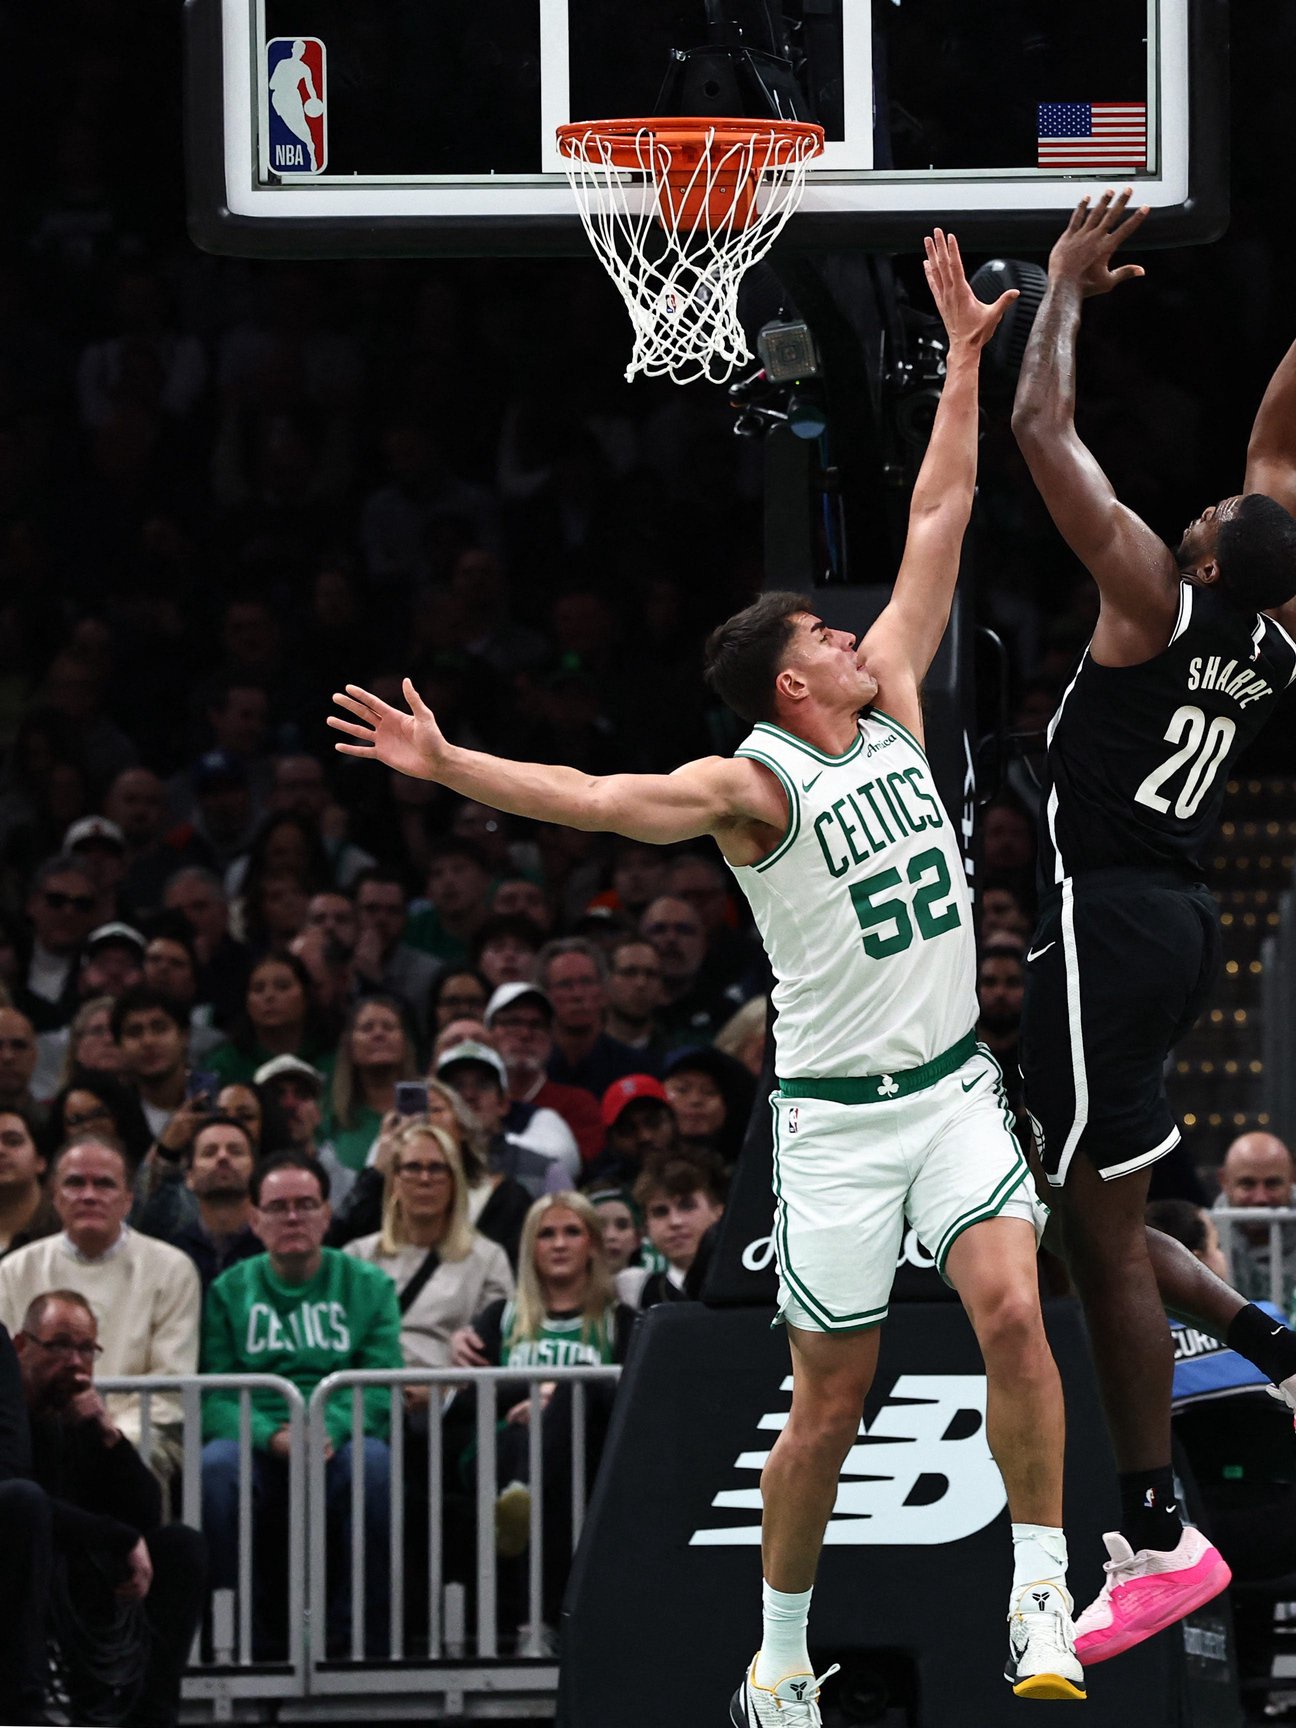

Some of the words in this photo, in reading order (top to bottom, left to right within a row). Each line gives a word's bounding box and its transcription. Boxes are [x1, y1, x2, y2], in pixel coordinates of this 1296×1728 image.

[275, 144, 304, 166] NBA
[1187, 655, 1273, 709] SHARPE
[1134, 705, 1236, 819] 20
[813, 766, 943, 878] CELTICS
[848, 847, 961, 960] 52
